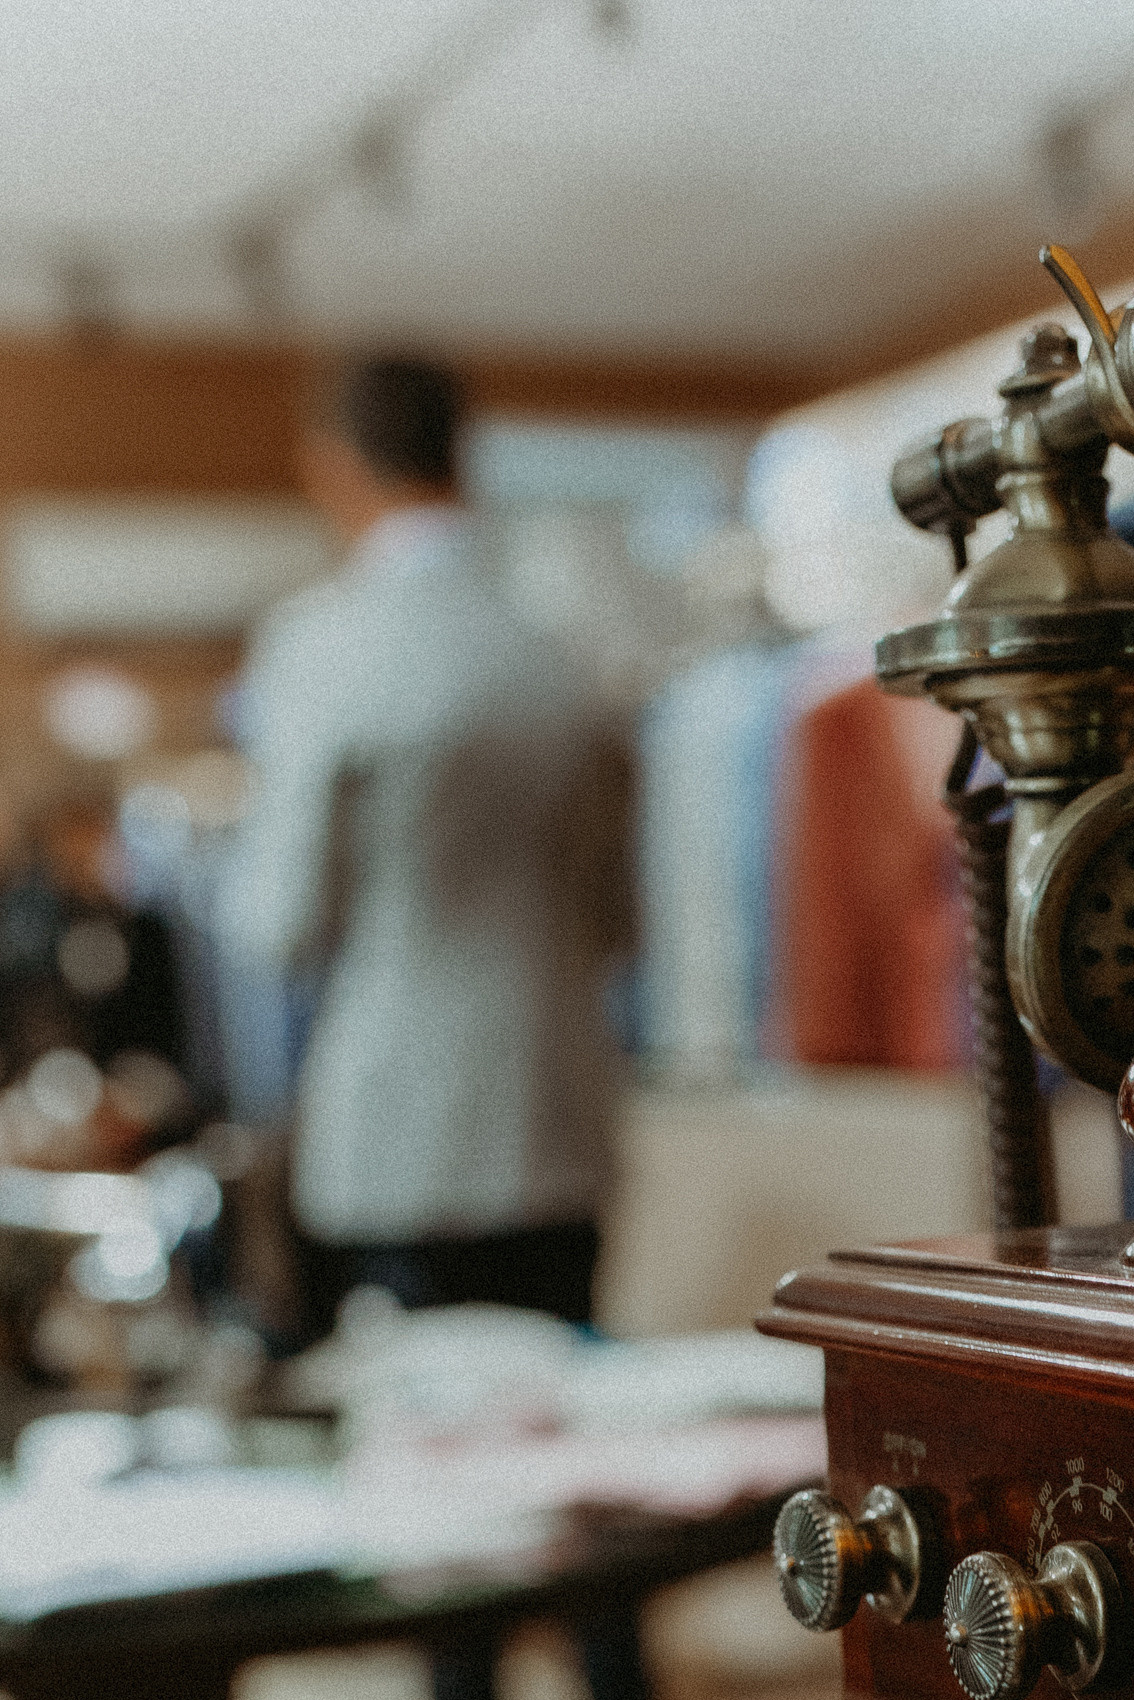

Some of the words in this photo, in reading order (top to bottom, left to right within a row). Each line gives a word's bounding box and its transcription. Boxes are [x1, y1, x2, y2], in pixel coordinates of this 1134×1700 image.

[1066, 1457, 1085, 1475] 1000
[1106, 1466, 1125, 1493] 1200
[1100, 1501, 1113, 1522] 100
